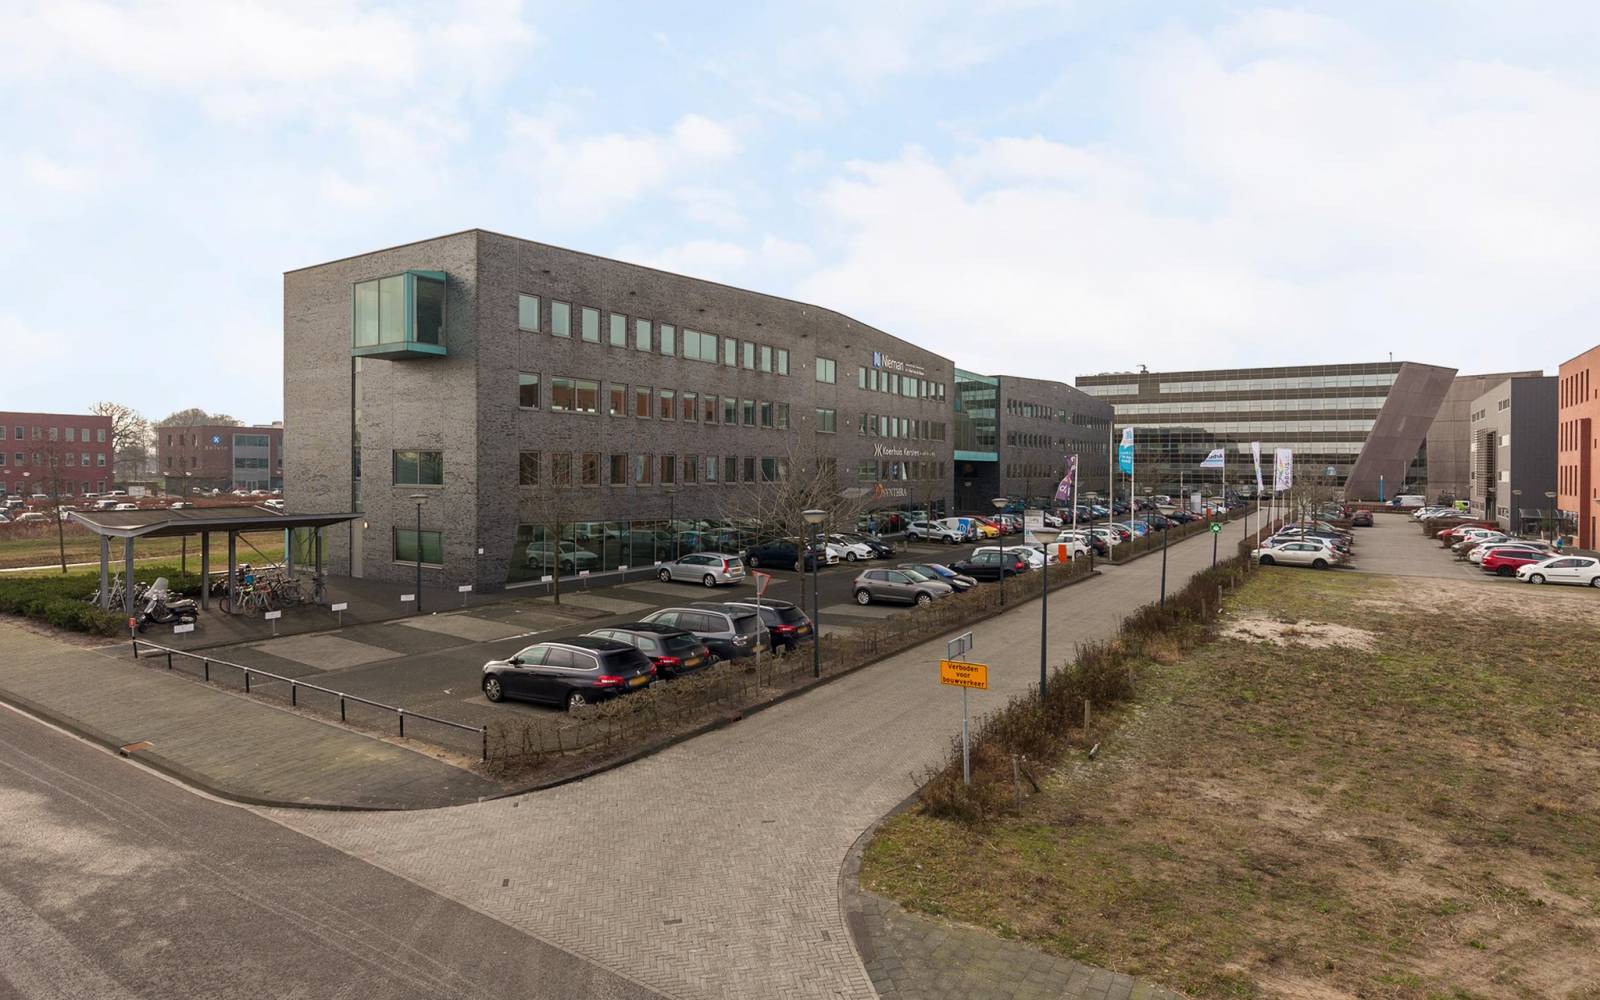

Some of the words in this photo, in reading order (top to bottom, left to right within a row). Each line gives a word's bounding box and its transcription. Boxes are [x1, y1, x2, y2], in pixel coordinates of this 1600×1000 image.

[881, 353, 904, 371] Nieman
[947, 662, 979, 673] Verboden
[943, 676, 985, 687] bouwverkeer
